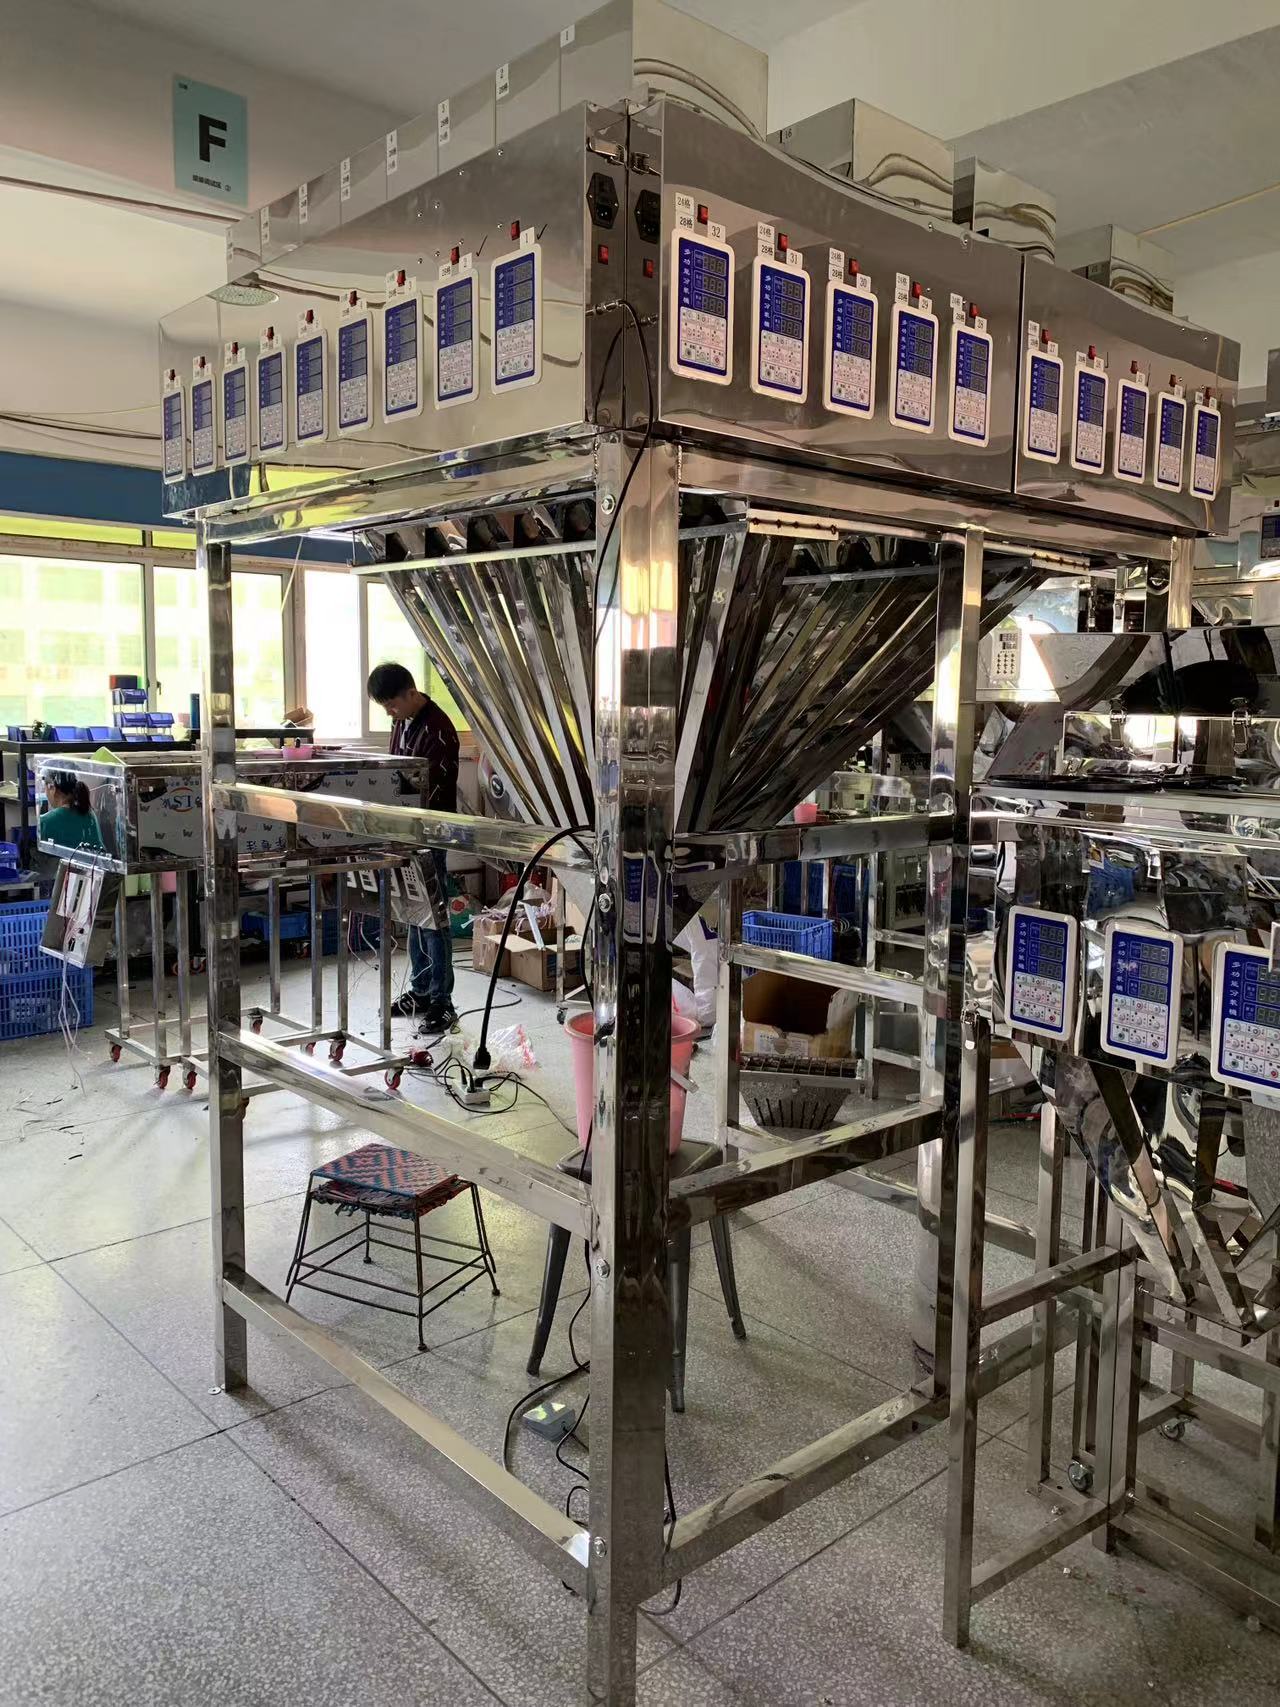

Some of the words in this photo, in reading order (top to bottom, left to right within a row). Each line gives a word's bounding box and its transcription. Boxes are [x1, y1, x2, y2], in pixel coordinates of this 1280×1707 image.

[199, 113, 227, 163] F
[785, 128, 793, 139] 16
[677, 196, 691, 208] 24格
[679, 216, 693, 230] 28格
[711, 226, 721, 239] 32
[761, 244, 774, 256] 28格
[789, 253, 798, 265] 31
[859, 278, 868, 288] 30
[921, 300, 929, 309] 29
